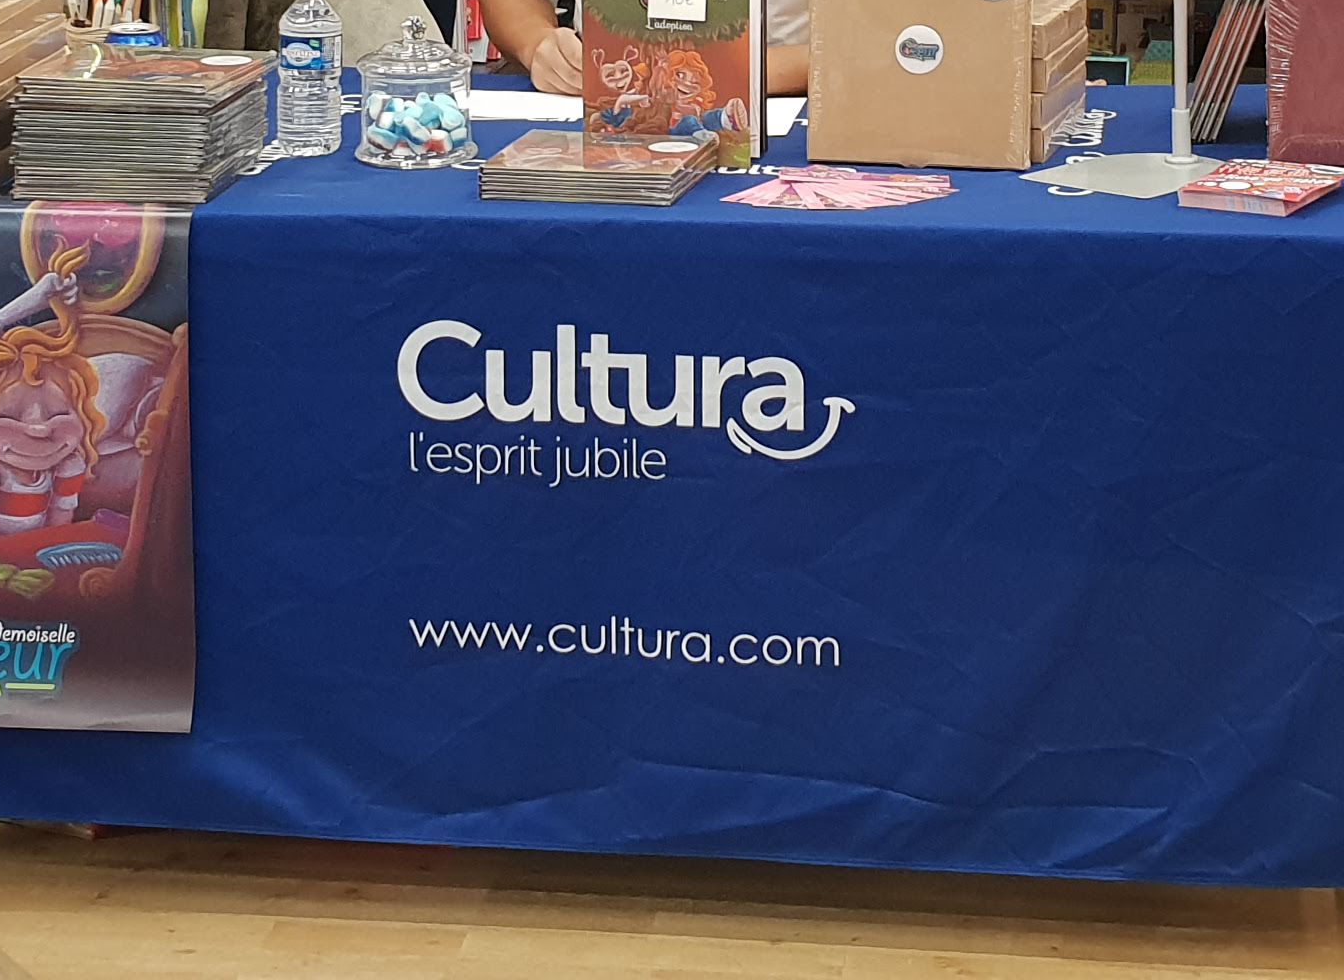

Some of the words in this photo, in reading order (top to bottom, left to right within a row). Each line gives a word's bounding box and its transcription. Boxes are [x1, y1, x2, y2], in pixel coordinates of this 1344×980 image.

[397, 319, 816, 440] Cultura
[409, 432, 542, 485] l'esprit
[550, 435, 667, 488] jubile
[409, 616, 841, 667] www.cultura.com
